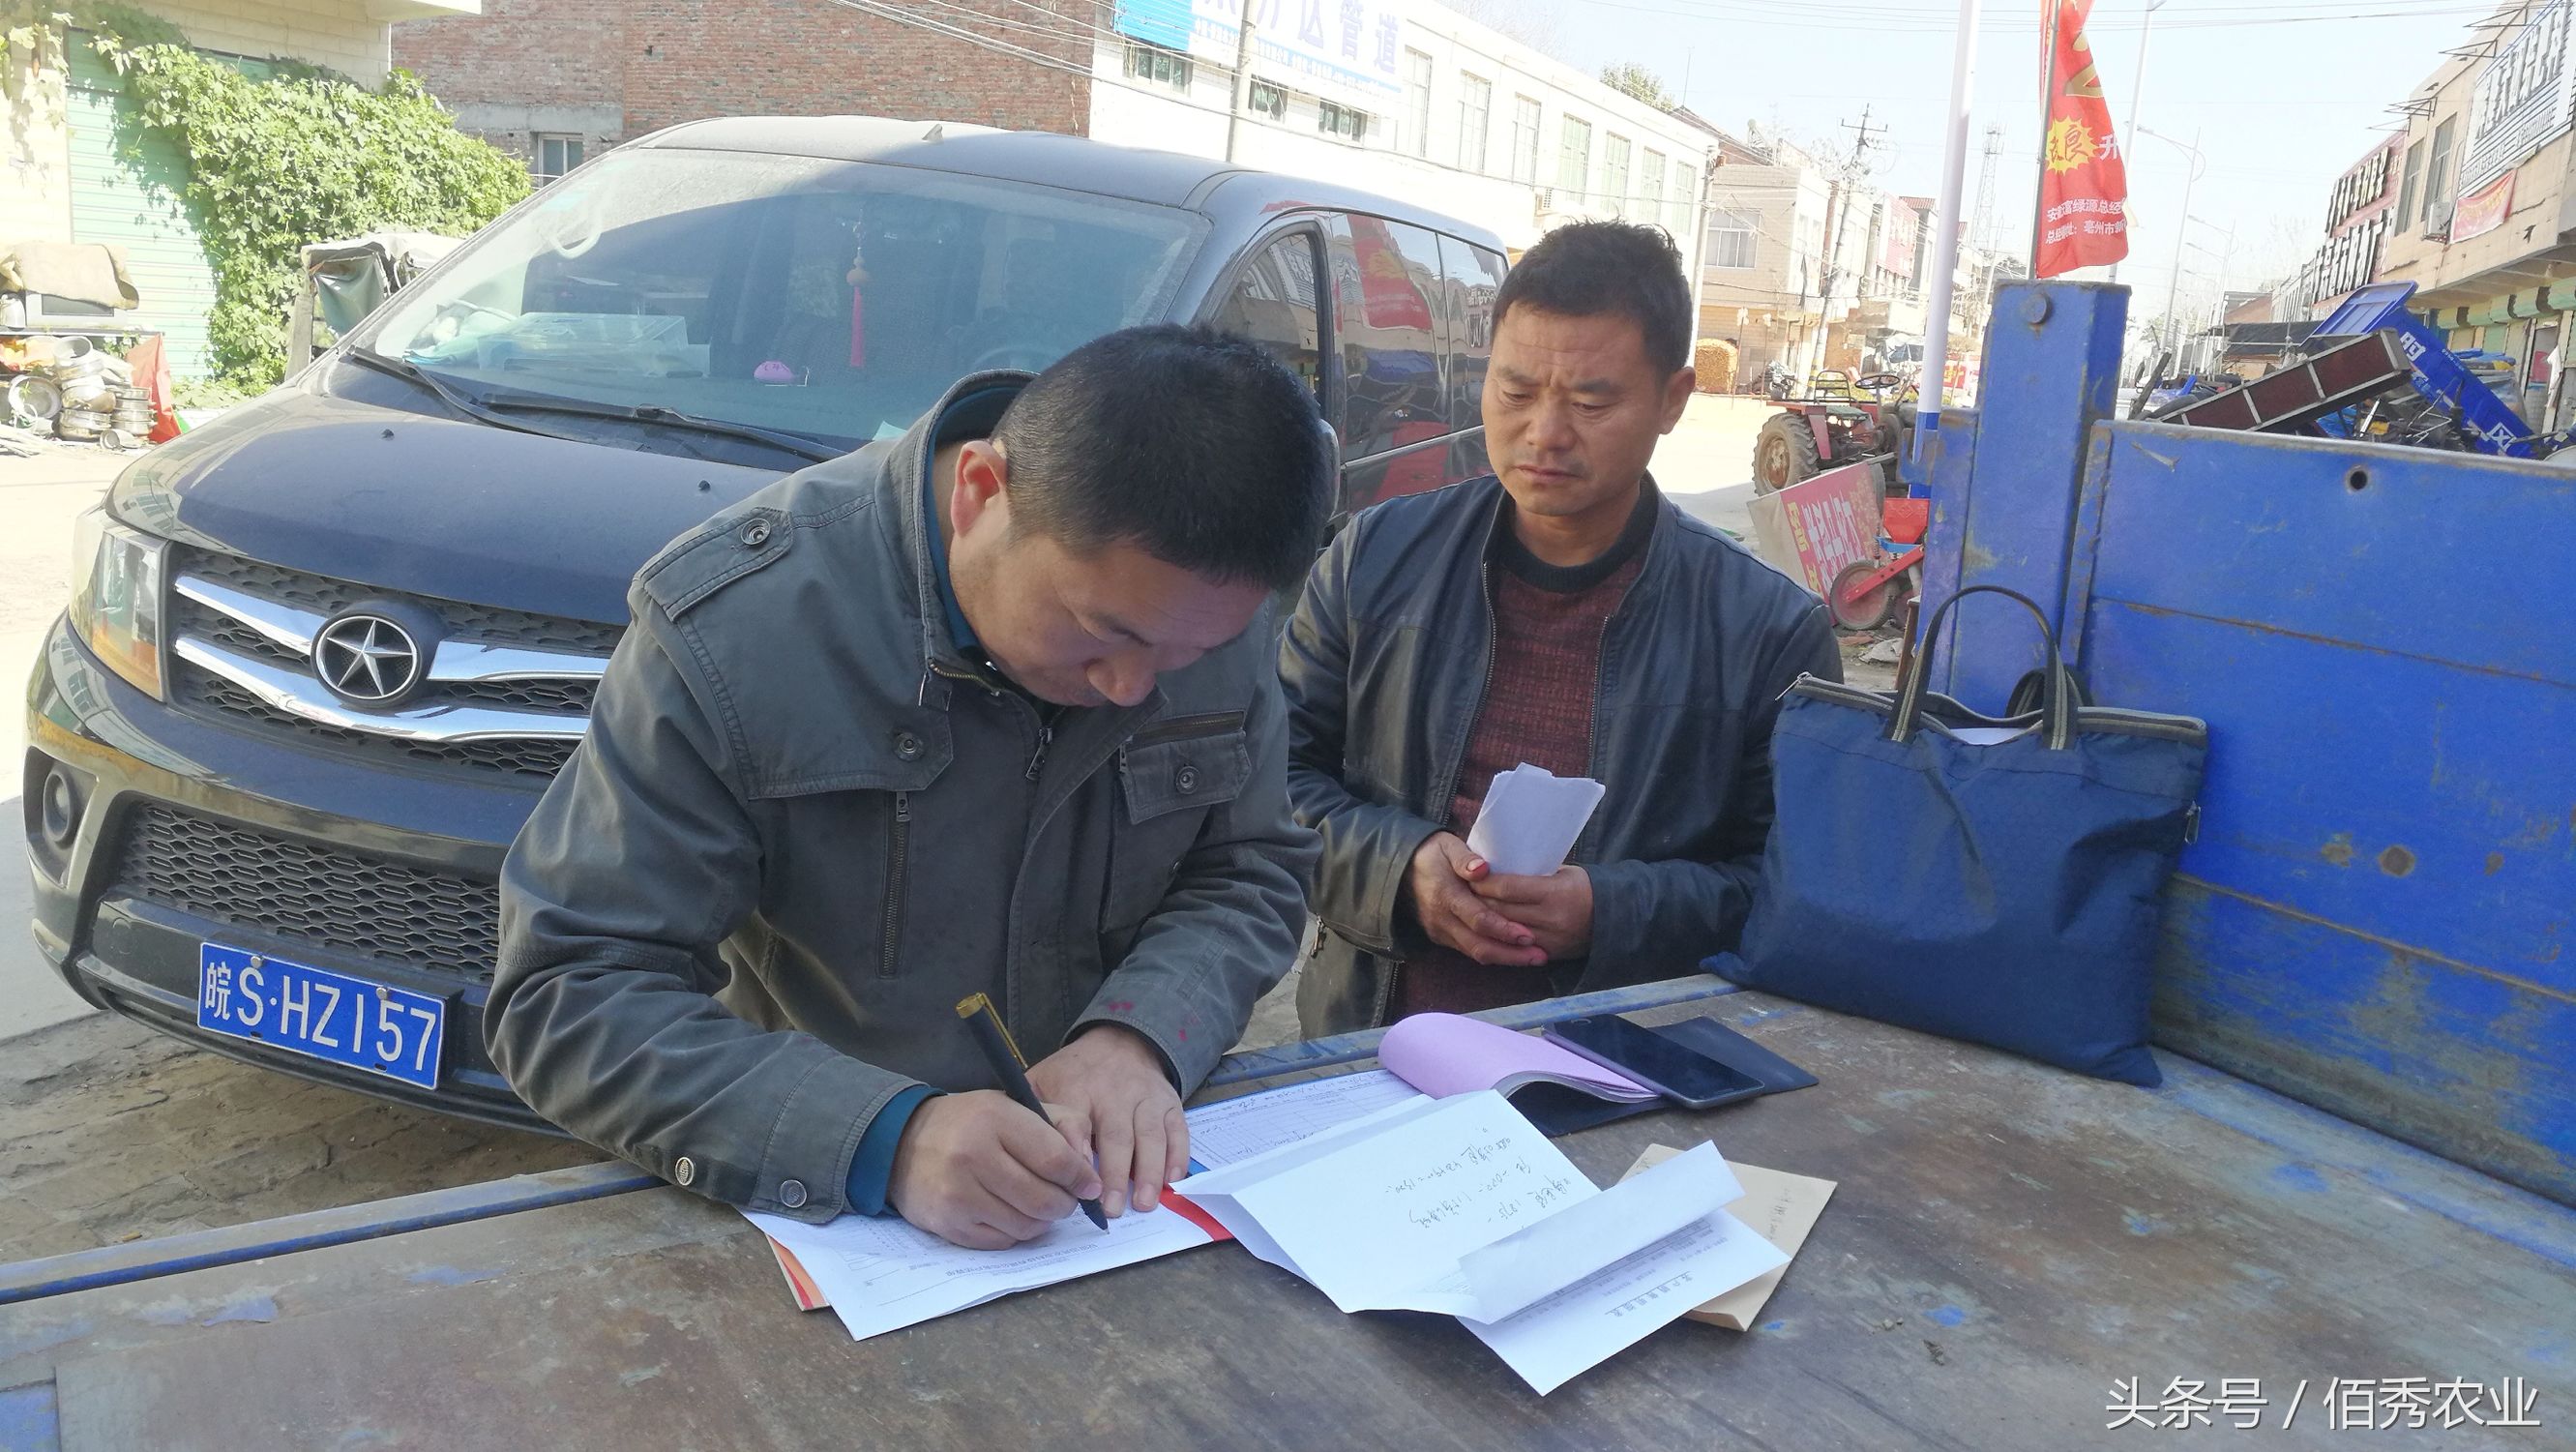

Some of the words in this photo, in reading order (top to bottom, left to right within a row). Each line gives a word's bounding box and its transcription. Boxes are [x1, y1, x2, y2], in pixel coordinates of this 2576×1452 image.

[2047, 197, 2127, 222] 安徽富绿源总经
[204, 961, 436, 1072] 皖S·HZ157
